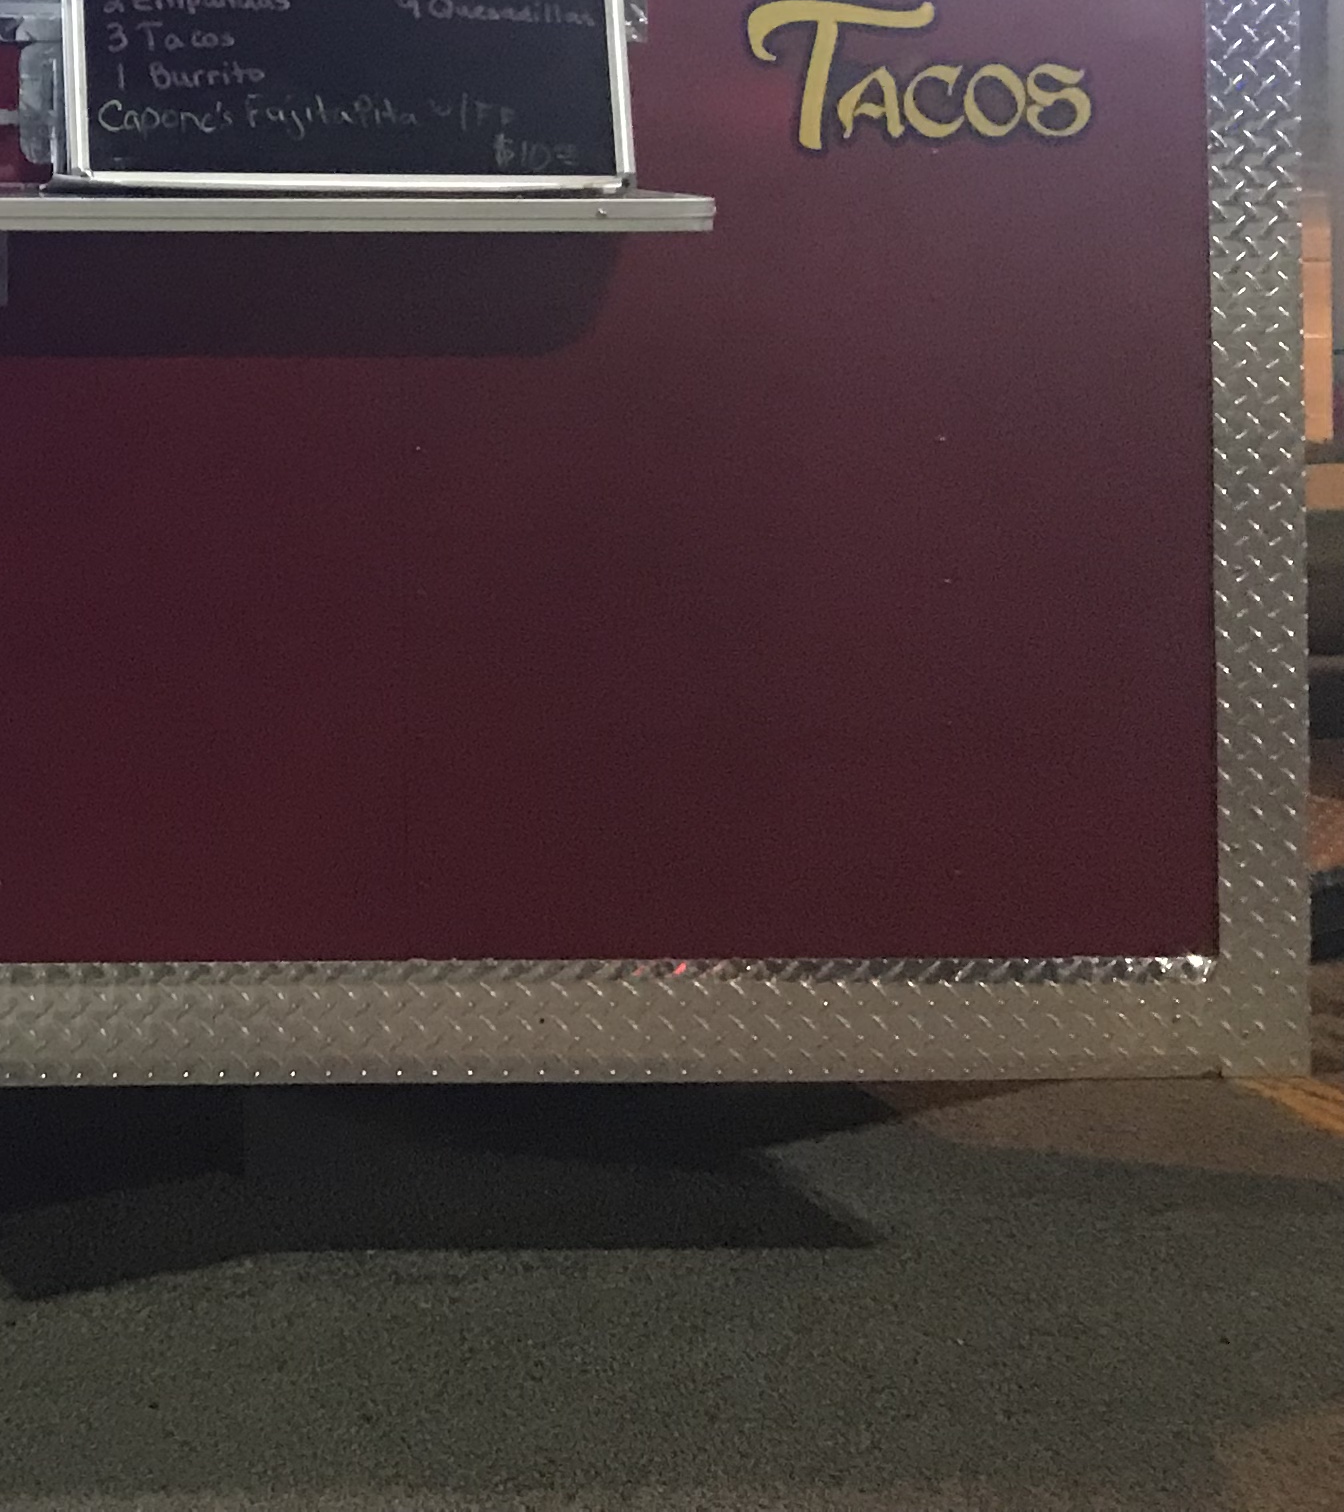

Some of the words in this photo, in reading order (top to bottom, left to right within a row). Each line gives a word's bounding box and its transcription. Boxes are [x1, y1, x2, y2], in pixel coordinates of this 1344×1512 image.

[105, 21, 130, 54] 3
[134, 20, 237, 52] Tacos
[116, 60, 127, 92] 1
[148, 59, 267, 91] Burrito
[96, 98, 235, 141] Capone's
